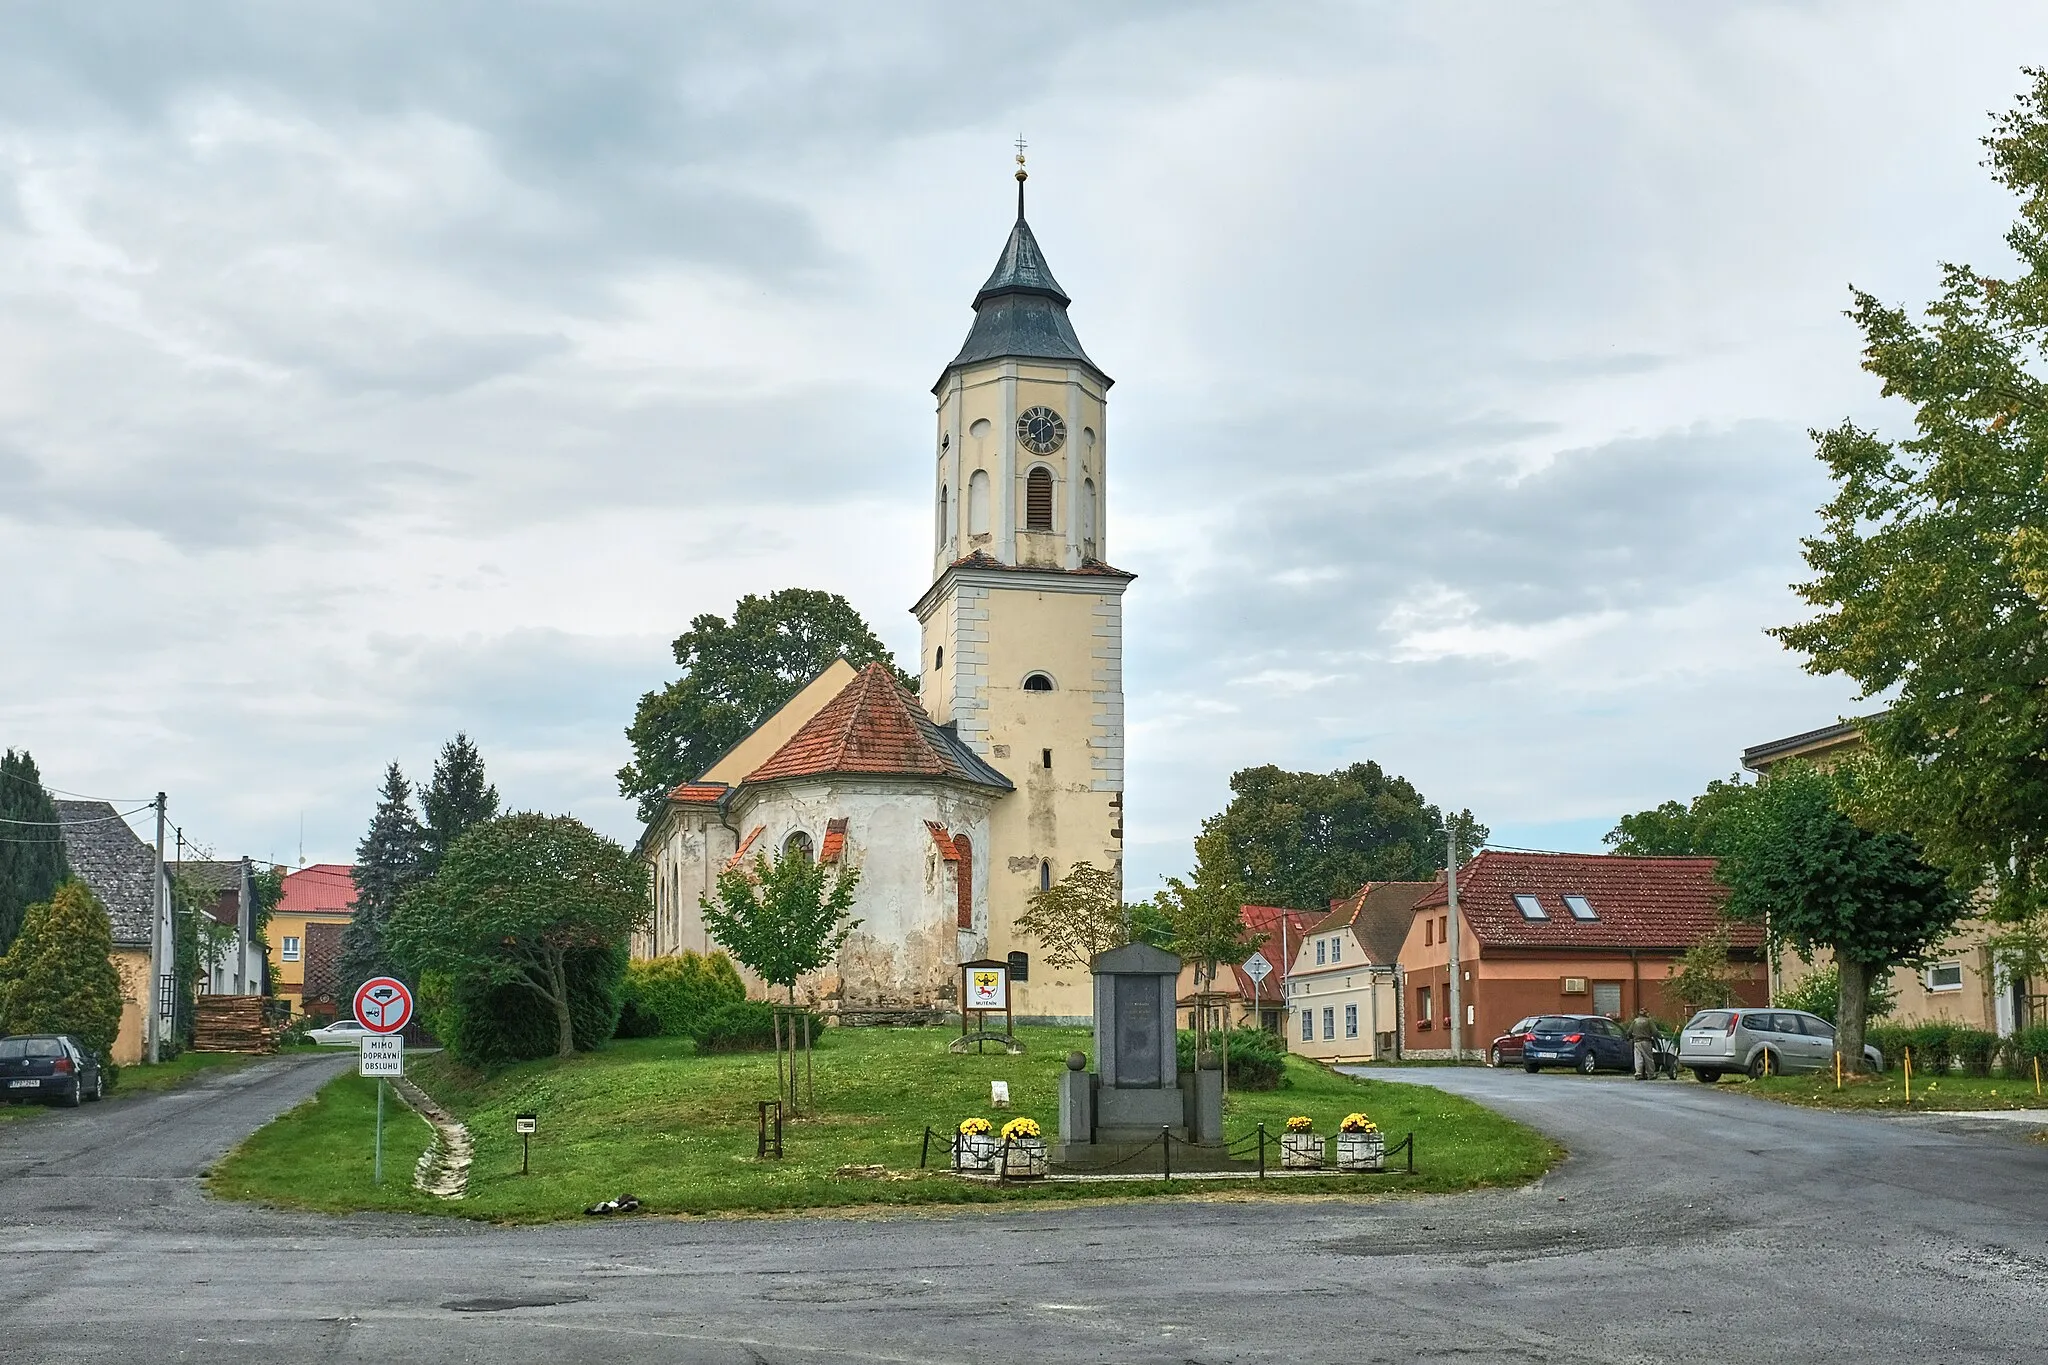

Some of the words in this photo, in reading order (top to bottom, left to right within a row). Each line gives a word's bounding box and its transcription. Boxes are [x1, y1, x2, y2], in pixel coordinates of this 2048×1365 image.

[371, 1041, 393, 1049] MIMO
[363, 1050, 400, 1059] DOPRAVNÍ
[365, 1062, 398, 1070] OBSLUHU
